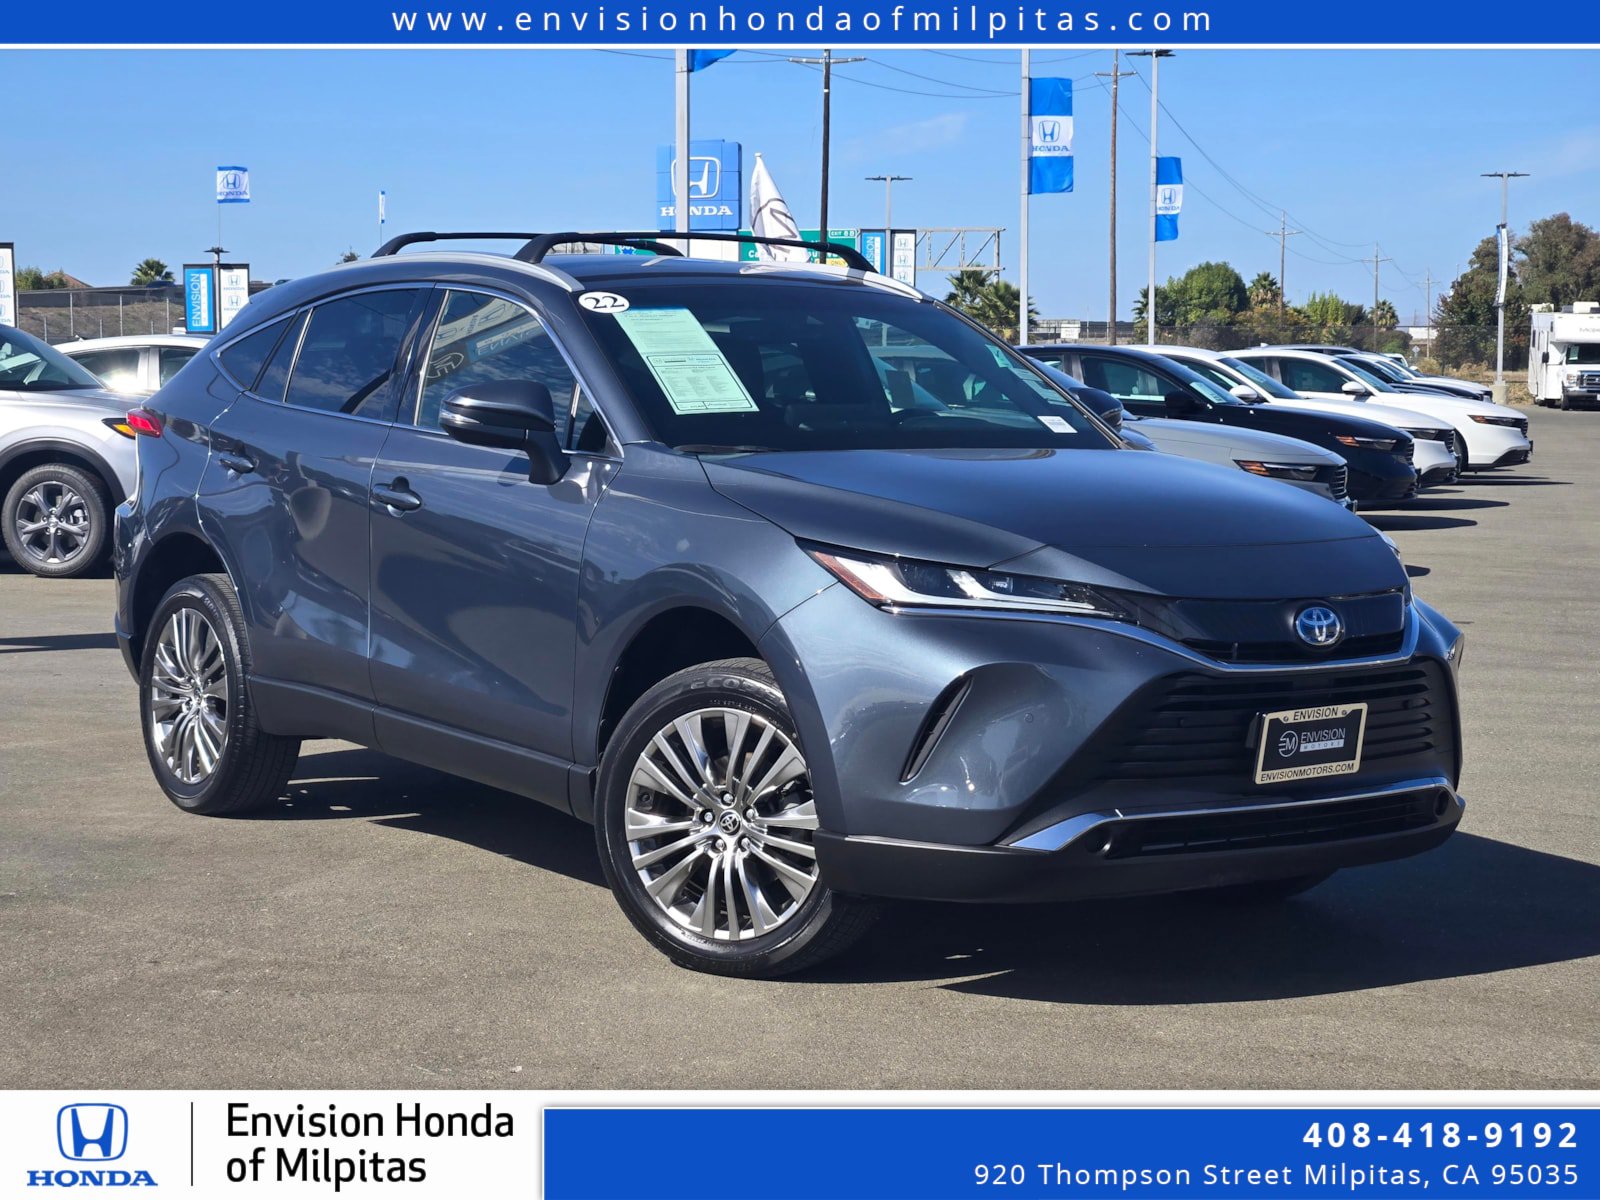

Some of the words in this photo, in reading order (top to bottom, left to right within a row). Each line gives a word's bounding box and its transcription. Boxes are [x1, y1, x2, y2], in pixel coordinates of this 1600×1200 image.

[660, 205, 733, 217] HNDA
[190, 273, 201, 327] ENVISION
[584, 295, 625, 309] 22
[1293, 707, 1338, 720] ENVISION
[1300, 728, 1346, 744] ENVISION
[1260, 763, 1354, 781] ENVISIONMOTORS.COM
